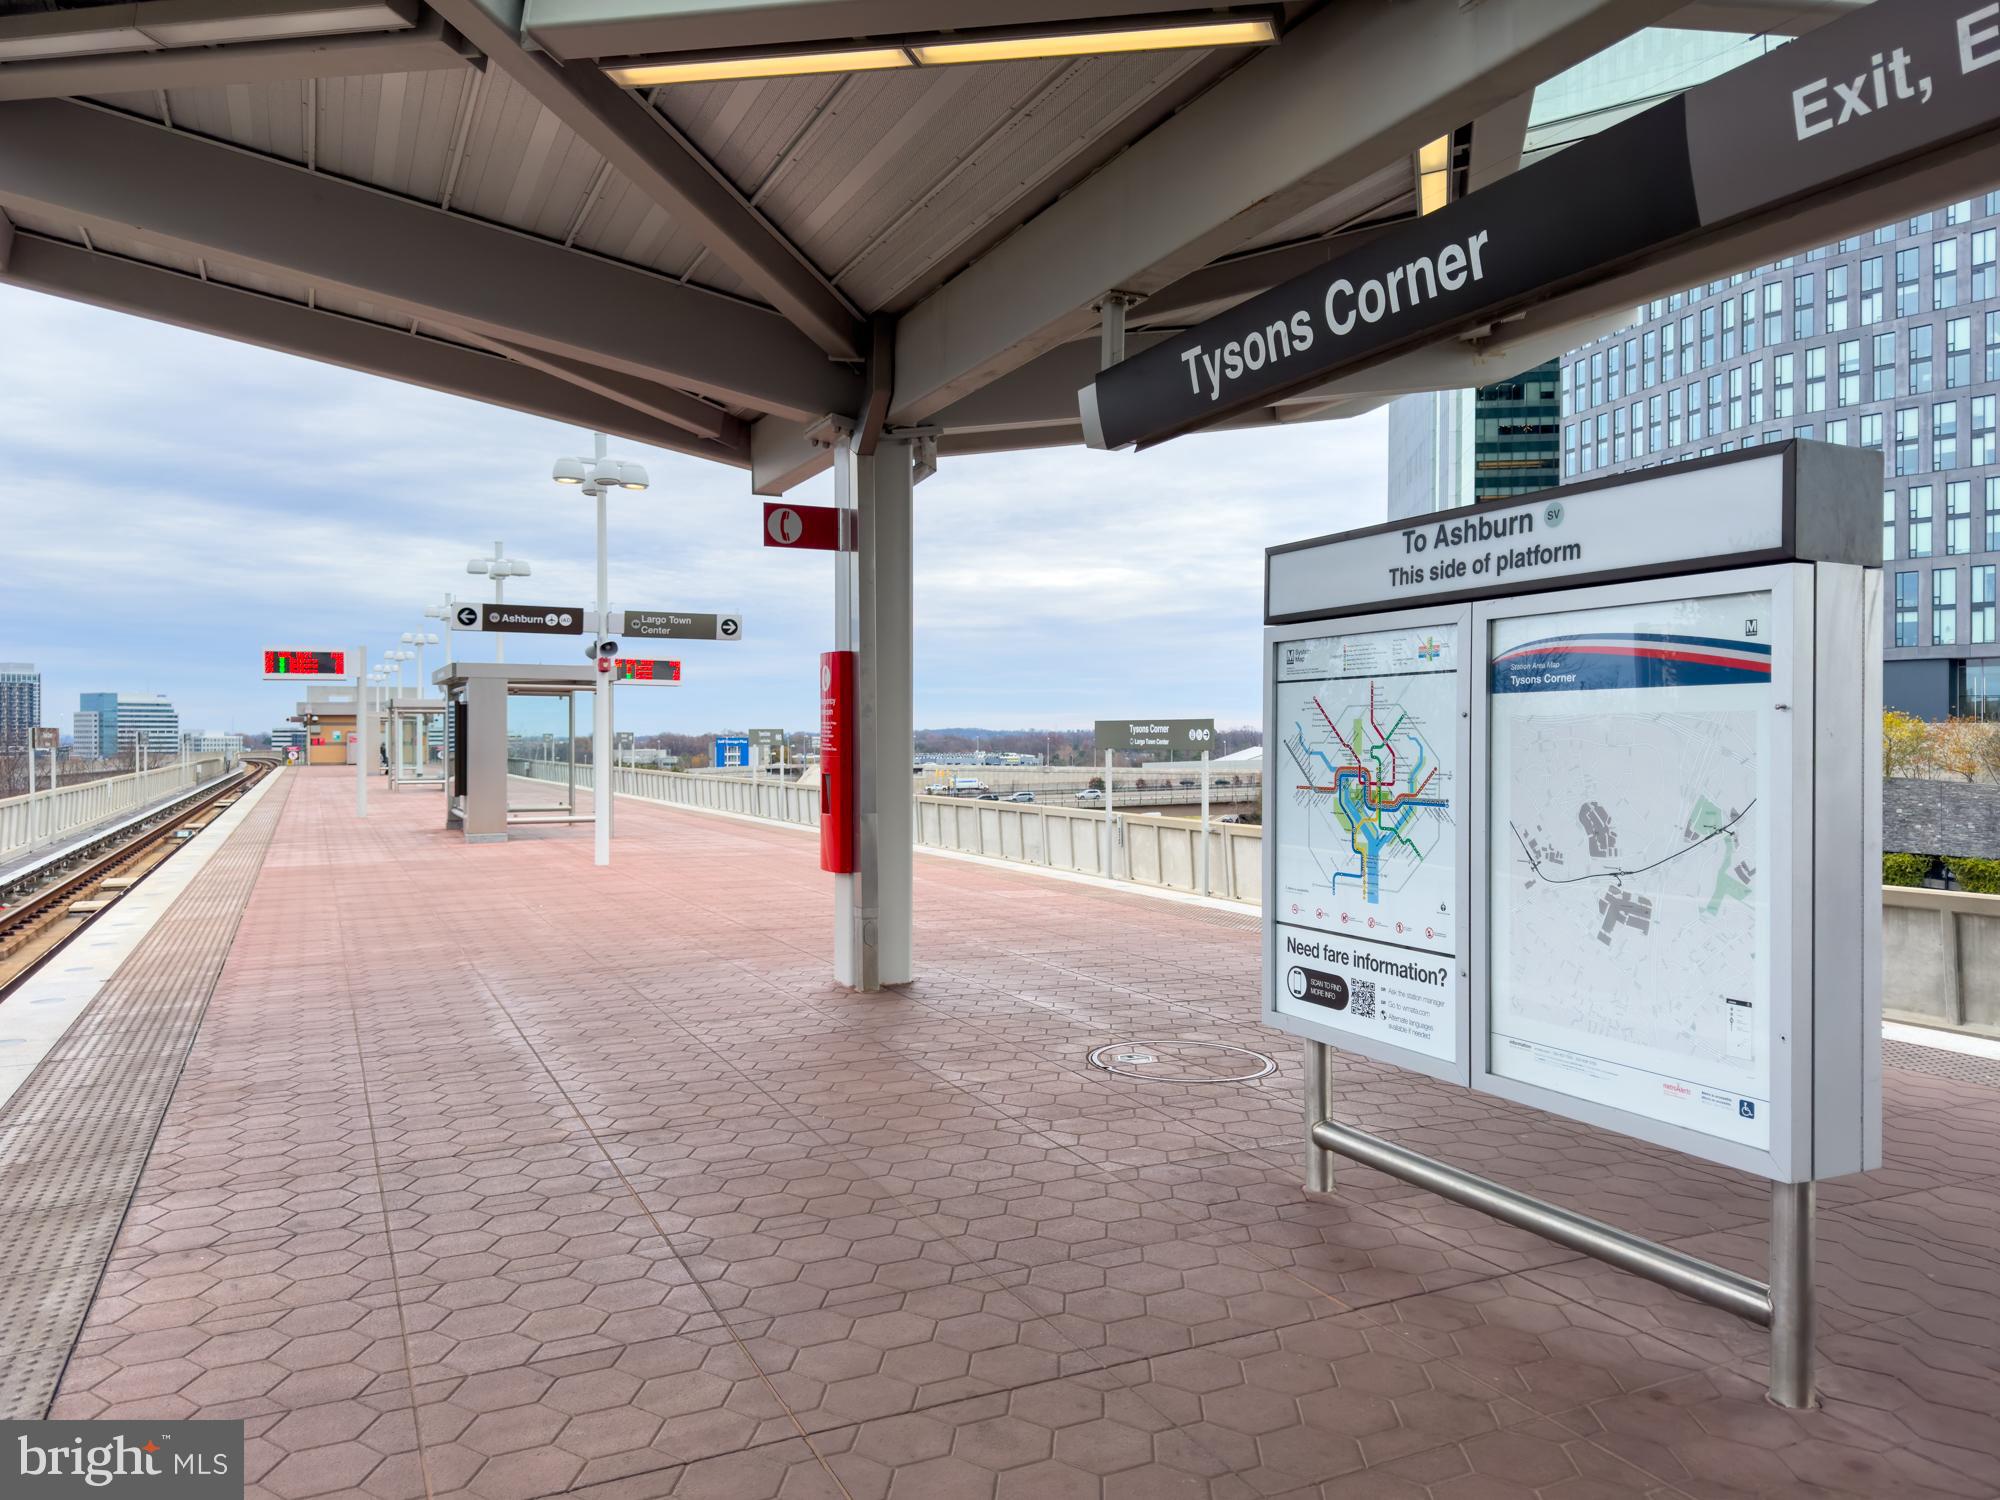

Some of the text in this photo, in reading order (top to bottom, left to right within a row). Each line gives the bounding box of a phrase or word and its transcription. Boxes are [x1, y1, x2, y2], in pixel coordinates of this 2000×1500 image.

[1792, 47, 1932, 141] Exit,
[1181, 230, 1488, 401] Tysons Corner
[1402, 508, 1560, 554] To Ashburn SV
[1389, 542, 1582, 587] This side of platform
[501, 613, 544, 624] Ashburn
[641, 615, 667, 625] Largo
[668, 615, 692, 624] Town
[641, 625, 671, 635] Center
[1510, 663, 1531, 671] Station
[1547, 661, 1560, 669] Map
[1510, 673, 1577, 687] Tysons Corner
[1129, 723, 1169, 735] Tysons Corner
[1287, 936, 1448, 987] Need fare information?
[1310, 978, 1342, 992] SCAN TO FIND
[1310, 987, 1336, 1000] MORE INFO
[1388, 1000, 1396, 1008] Go
[1402, 1006, 1431, 1017] wmata.com
[1422, 997, 1445, 1008] manager
